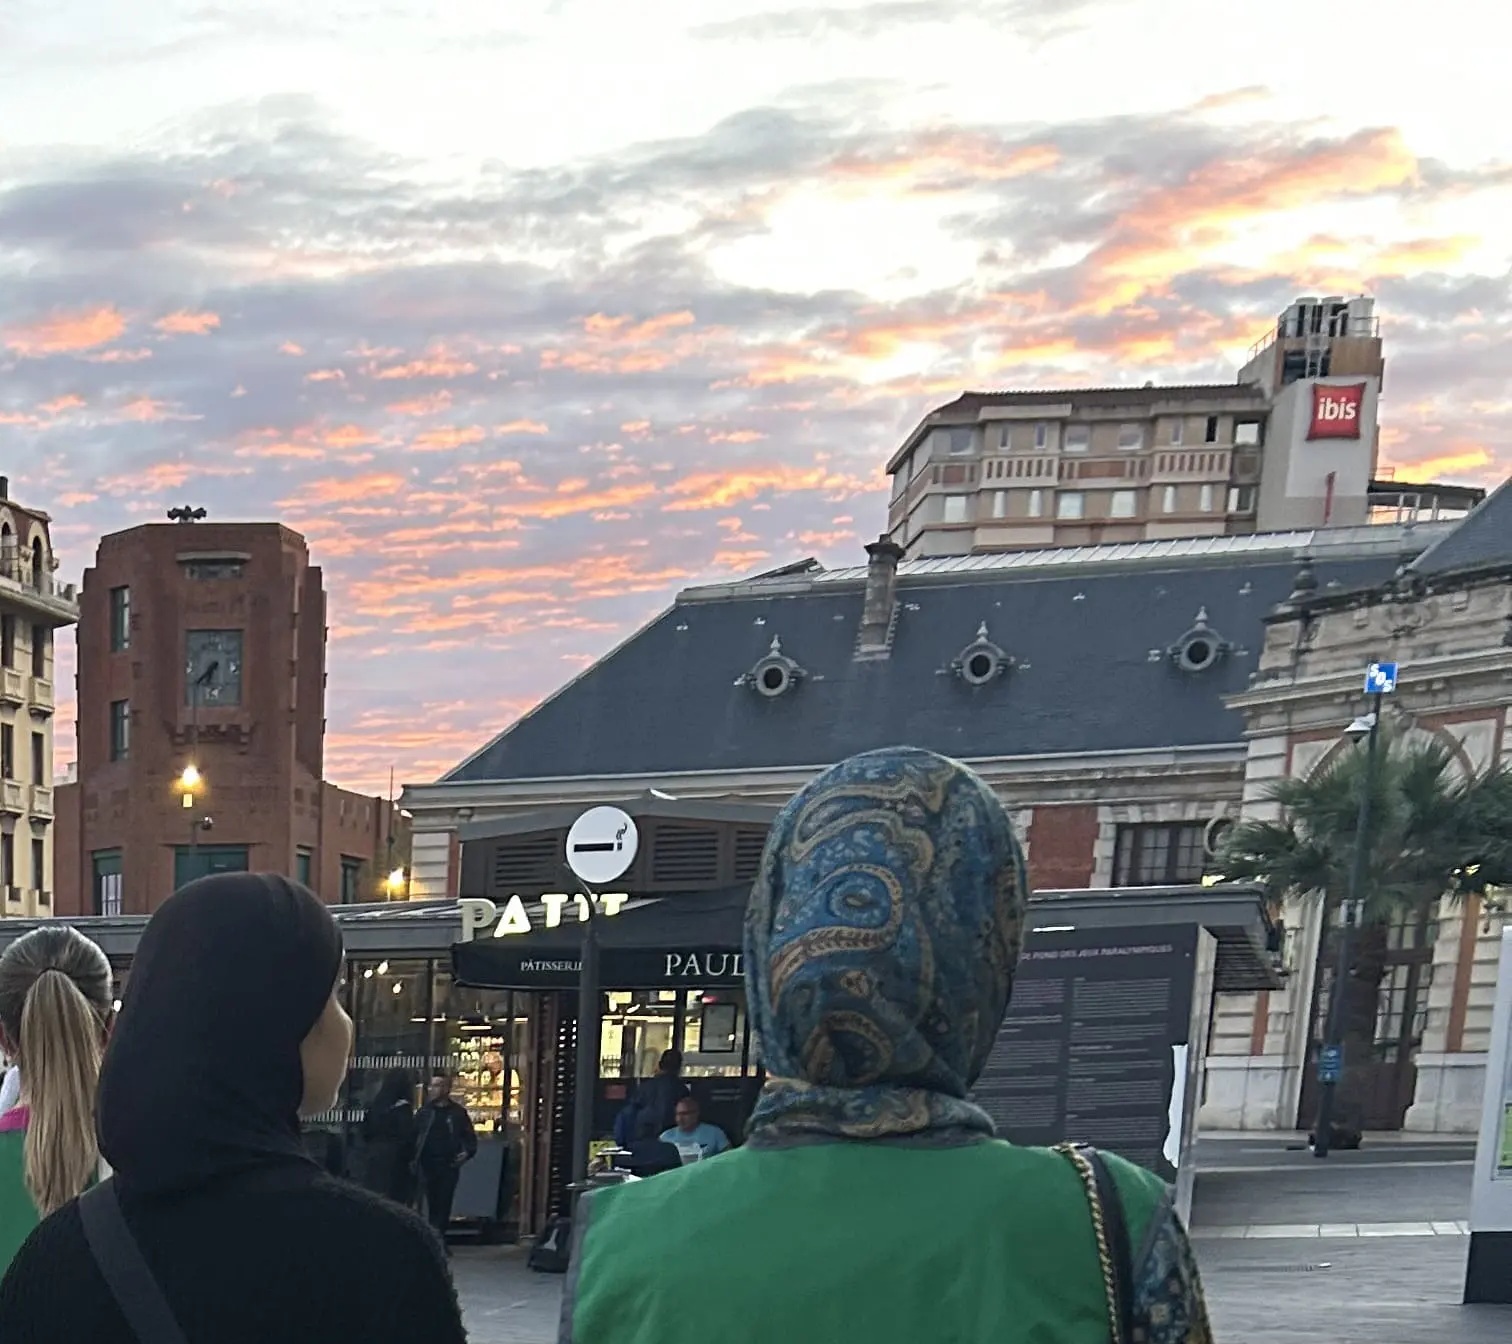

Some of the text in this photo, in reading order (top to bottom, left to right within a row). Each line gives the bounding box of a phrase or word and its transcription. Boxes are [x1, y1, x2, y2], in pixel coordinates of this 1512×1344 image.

[1318, 397, 1357, 420] ibis
[1369, 663, 1393, 692] SOS
[663, 953, 746, 977] PAUL
